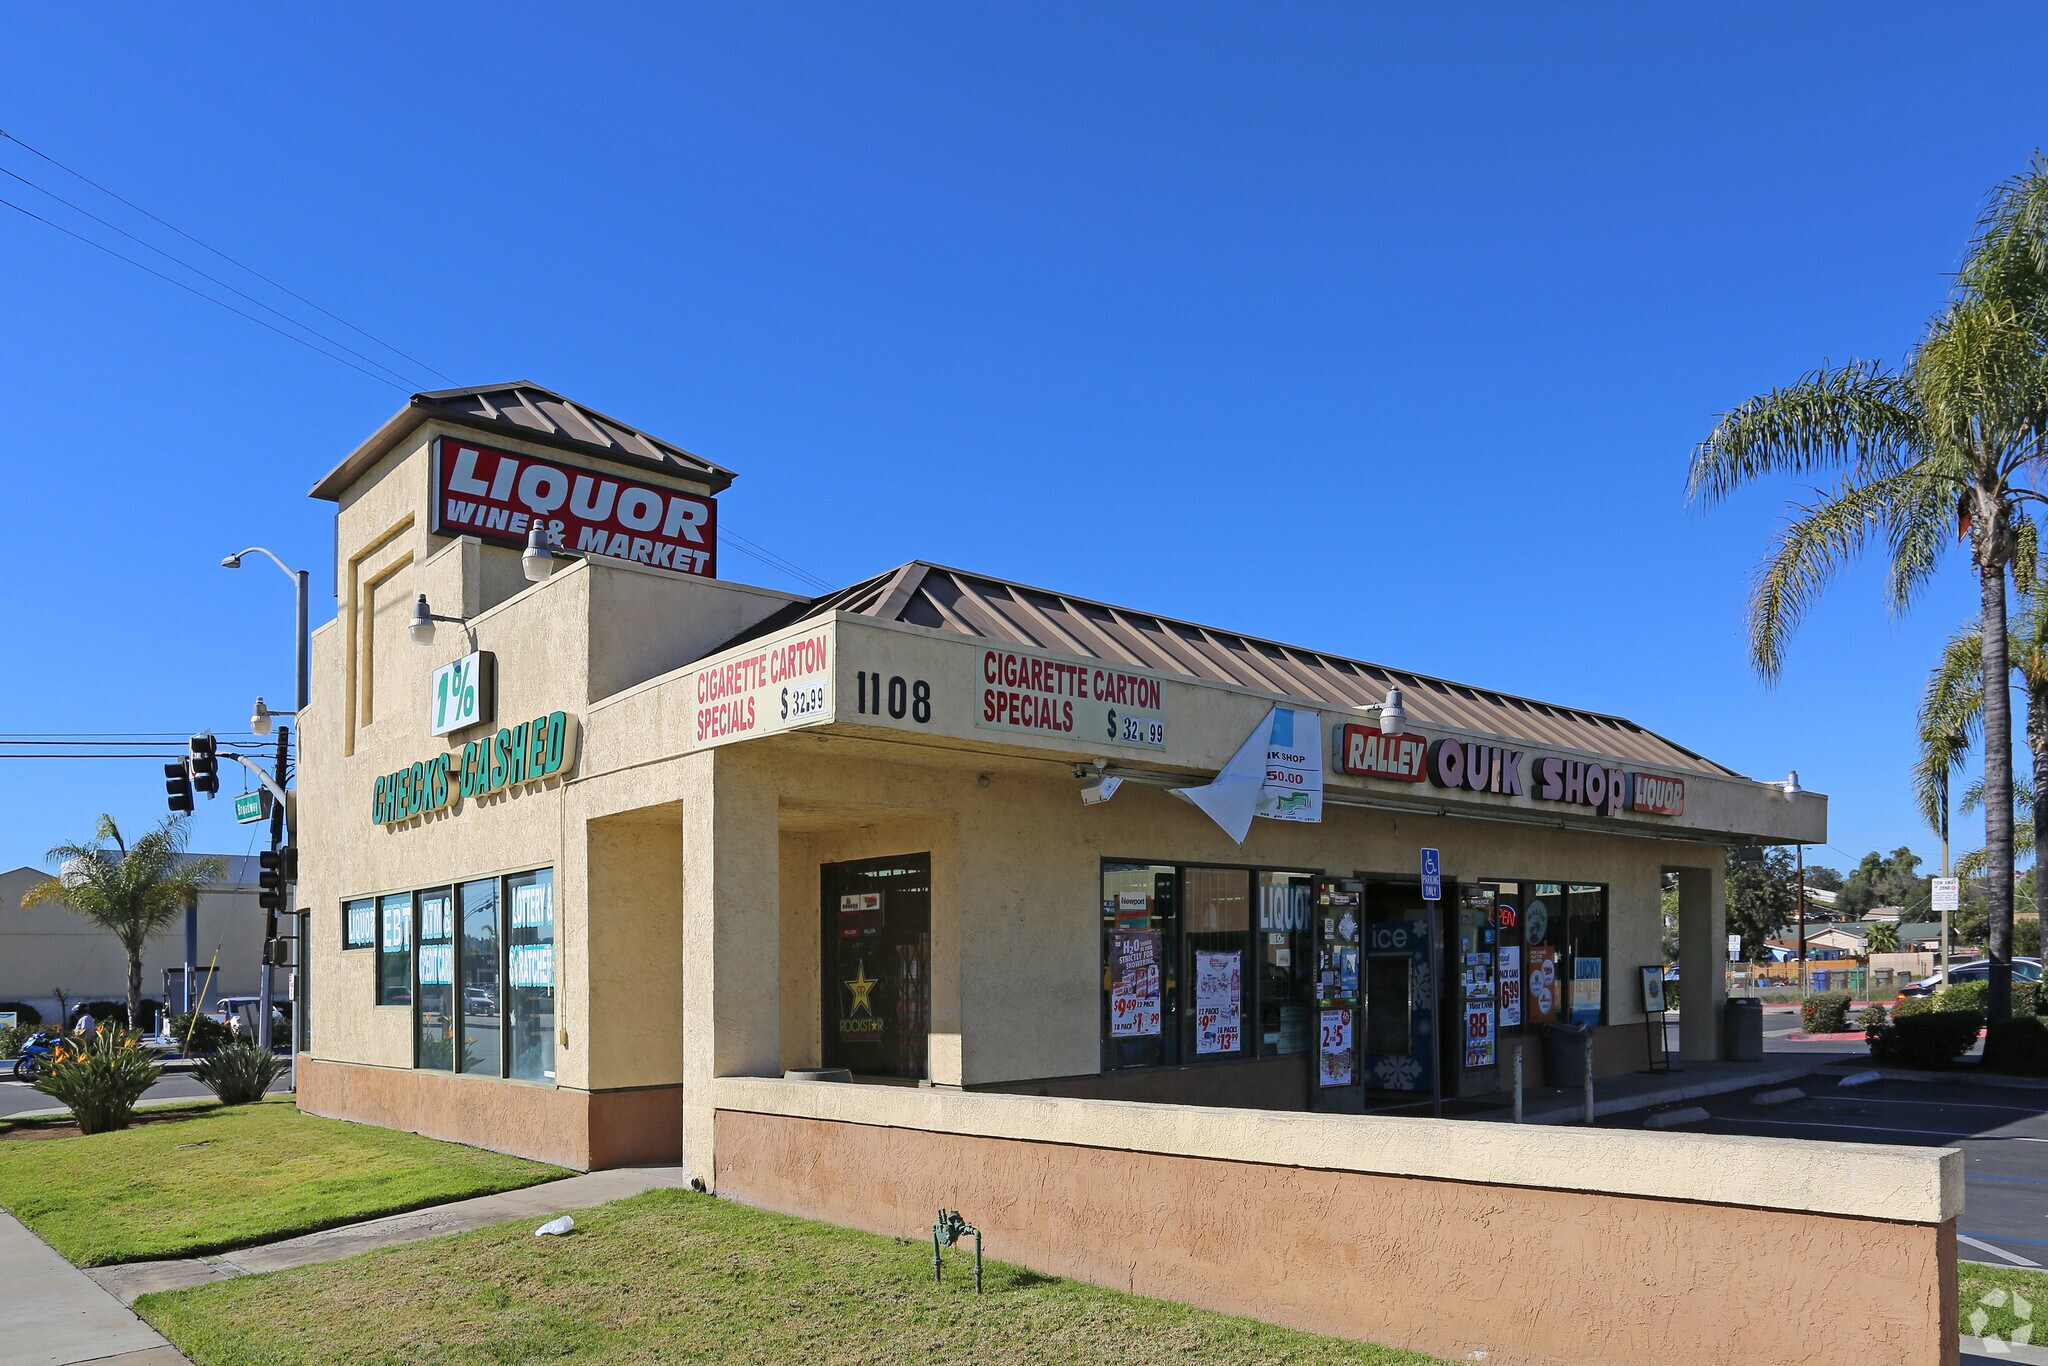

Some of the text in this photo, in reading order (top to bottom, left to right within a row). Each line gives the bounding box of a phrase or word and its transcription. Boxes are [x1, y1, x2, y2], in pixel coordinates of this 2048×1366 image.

[448, 447, 708, 543] LIQUOR
[447, 498, 710, 574] WINE & MARKET
[697, 635, 827, 705] CIGARETTE CARTON
[984, 651, 1160, 710] CIGARETTE CARTON
[437, 660, 474, 728] 1%
[857, 671, 931, 723] 1108
[697, 696, 755, 741] SPECIALS
[984, 689, 1073, 733] SPECIALS
[372, 711, 567, 825] CHECKS CASHED
[1281, 753, 1305, 763] SHOP
[1349, 734, 1426, 775] RALLEY
[1266, 770, 1304, 784] 50.00
[1438, 738, 1683, 816] QUIK SHOP LIQUOR
[237, 801, 258, 815] Broadway
[1422, 874, 1439, 885] PARKING
[1426, 886, 1437, 896] ONLY
[512, 884, 545, 928] LOTTERY
[1121, 897, 1145, 905] Newport
[383, 903, 410, 952] EBT
[422, 898, 442, 938] ATM
[1371, 923, 1408, 949] ice
[1120, 950, 1154, 965] STRICTLY FOR
[1509, 969, 1519, 979] CANS
[1576, 960, 1600, 980] LUCKY
[1482, 1001, 1493, 1009] CANS
[1224, 1026, 1238, 1034] PACKS
[1322, 1026, 1330, 1047] 2
[1470, 1013, 1487, 1038] 88
